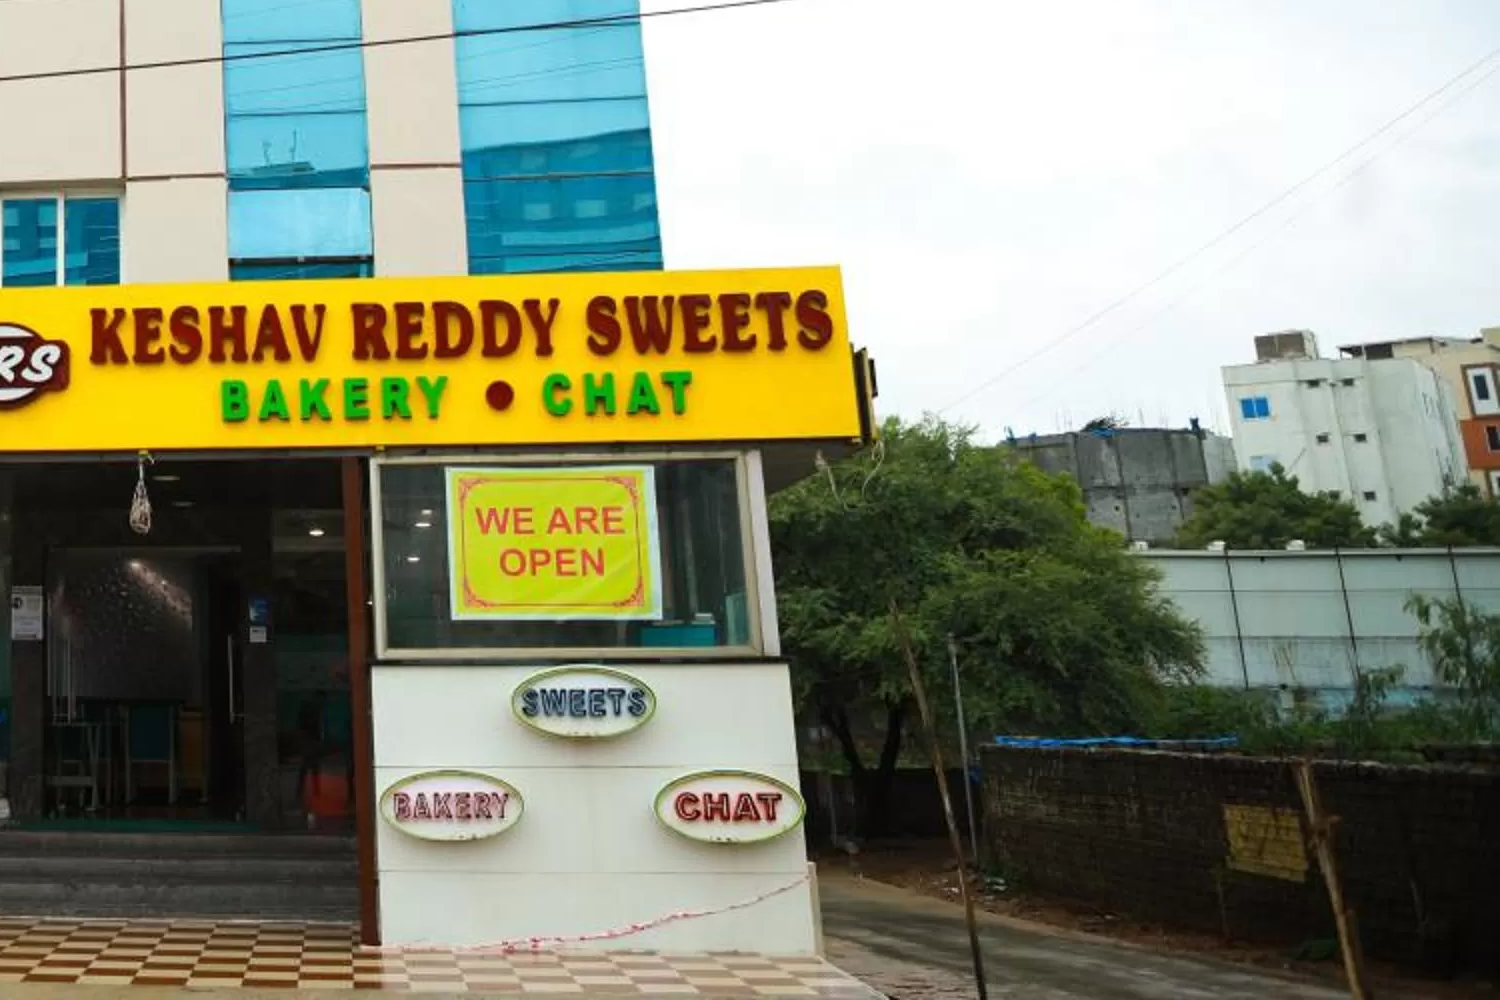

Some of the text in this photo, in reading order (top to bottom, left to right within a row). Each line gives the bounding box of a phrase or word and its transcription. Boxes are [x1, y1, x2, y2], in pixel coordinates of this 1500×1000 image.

[89, 289, 834, 366] KESHAV REDDY SWEETS
[221, 369, 693, 424] BAKERY CHAT
[475, 506, 625, 535] WE ARE
[500, 549, 606, 577] OPEN
[522, 688, 647, 718] SWEETS
[394, 792, 510, 822] BAKERY
[675, 792, 782, 822] CHAT
